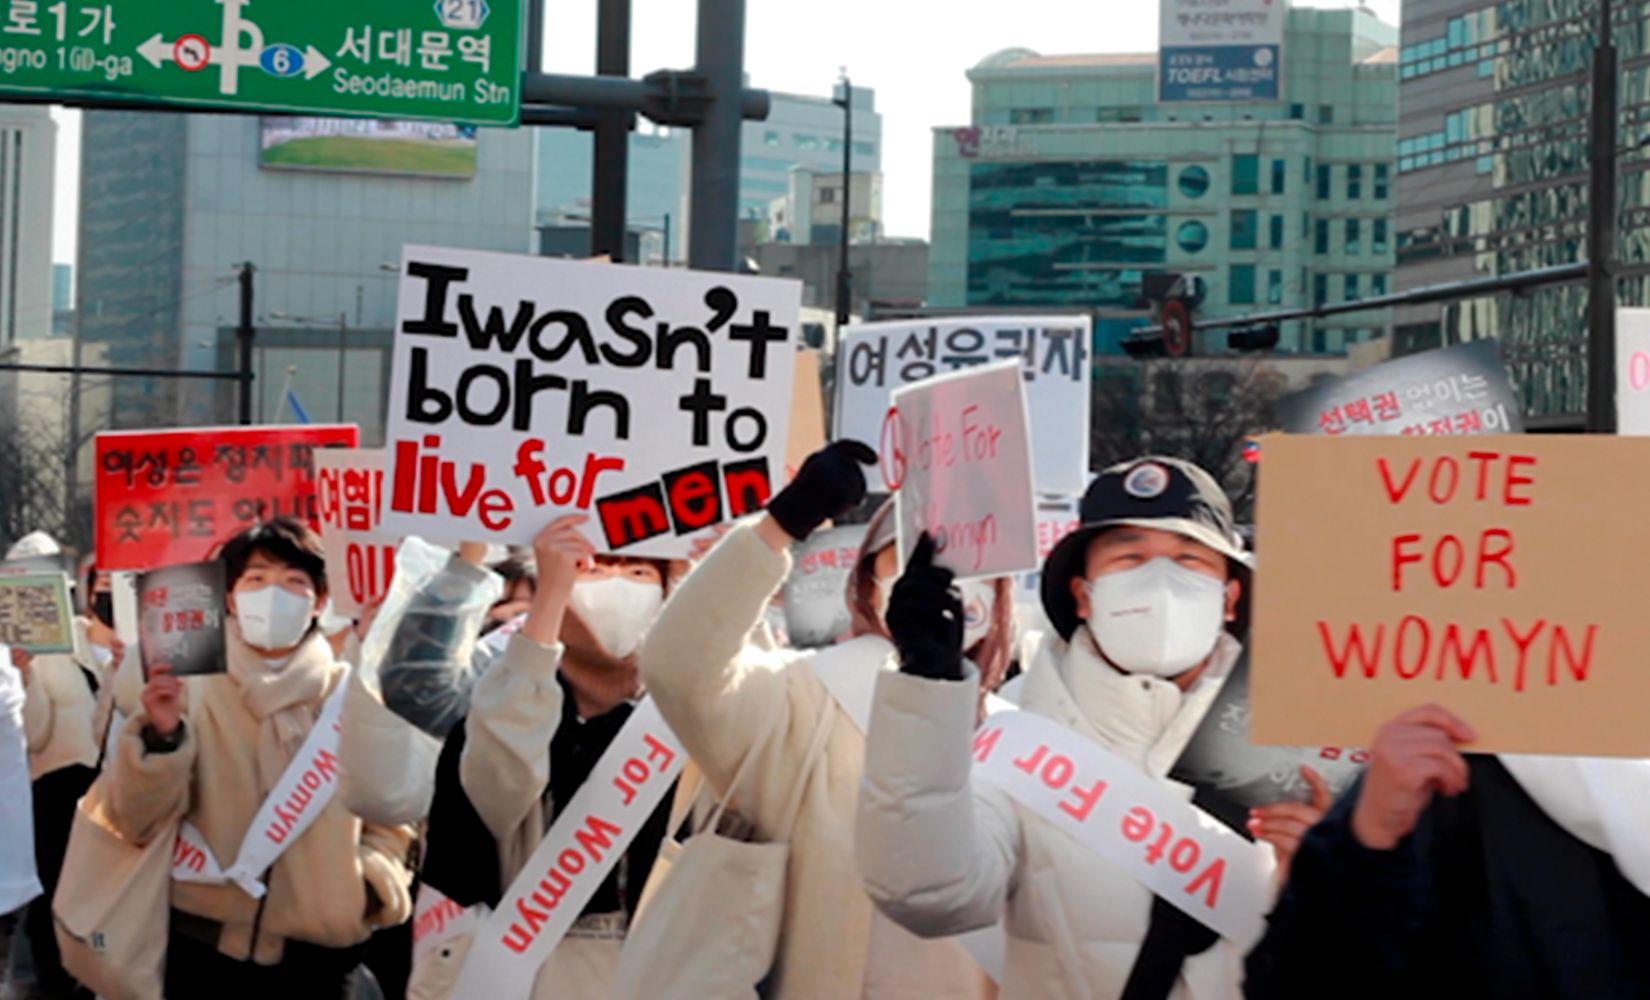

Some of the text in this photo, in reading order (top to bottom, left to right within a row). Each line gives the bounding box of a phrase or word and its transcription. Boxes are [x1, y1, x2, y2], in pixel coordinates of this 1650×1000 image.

[446, 0, 478, 21] 21
[273, 49, 291, 74] 6
[336, 25, 491, 73] 서대문역
[1168, 67, 1223, 84] TOEFL
[333, 67, 510, 104] Seodaemun Stn
[850, 327, 1088, 388] 여성유권자
[406, 346, 768, 453] born to
[1319, 390, 1402, 436] 선택권
[962, 403, 1002, 463] For
[103, 448, 202, 488] 여성은
[391, 434, 772, 547] live for men
[1376, 451, 1539, 507] VOTE
[920, 508, 998, 571] omyn
[1390, 527, 1519, 592] FOR
[1316, 614, 1600, 693] WOMYN
[264, 748, 337, 845] Womyn
[611, 732, 676, 807] For
[1012, 744, 1108, 823] For
[501, 814, 623, 954] Womyn
[1120, 804, 1229, 910] Vote
